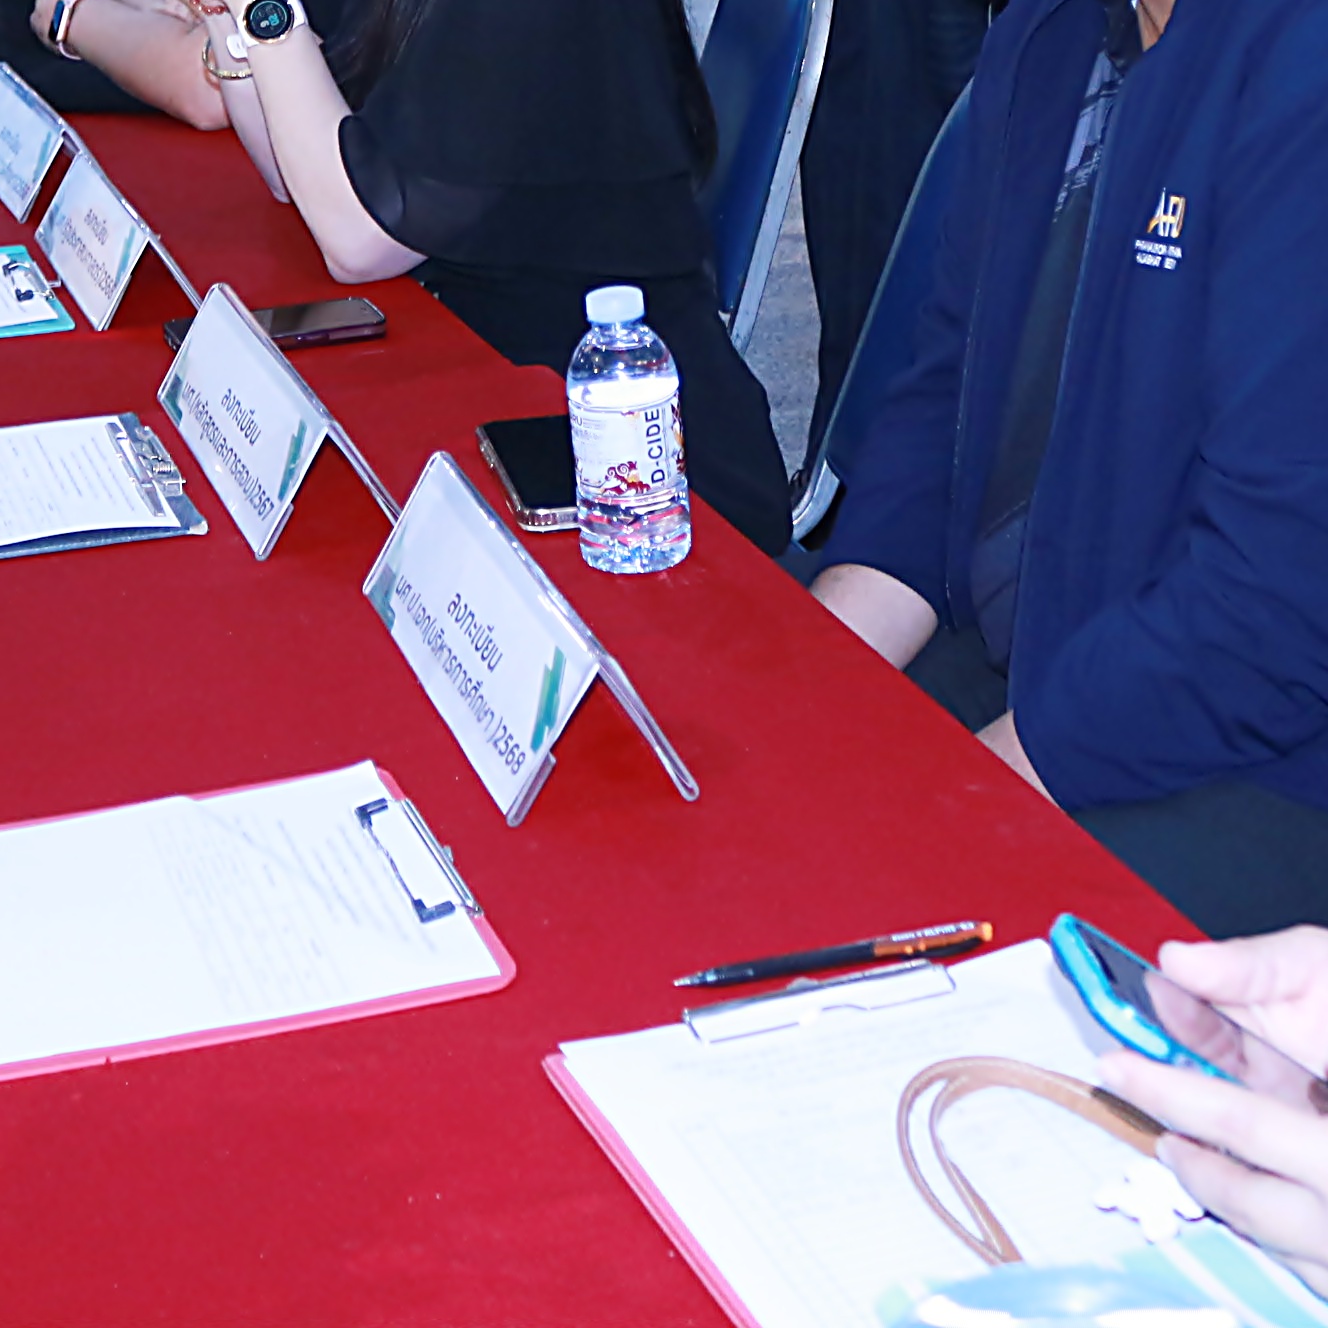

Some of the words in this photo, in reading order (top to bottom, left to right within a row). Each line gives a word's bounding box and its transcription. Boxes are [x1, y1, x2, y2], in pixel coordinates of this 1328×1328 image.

[220, 388, 262, 447] ลงทะเบียน
[644, 408, 665, 484] D-CIDE
[446, 592, 503, 674] ลงทะเบียน
